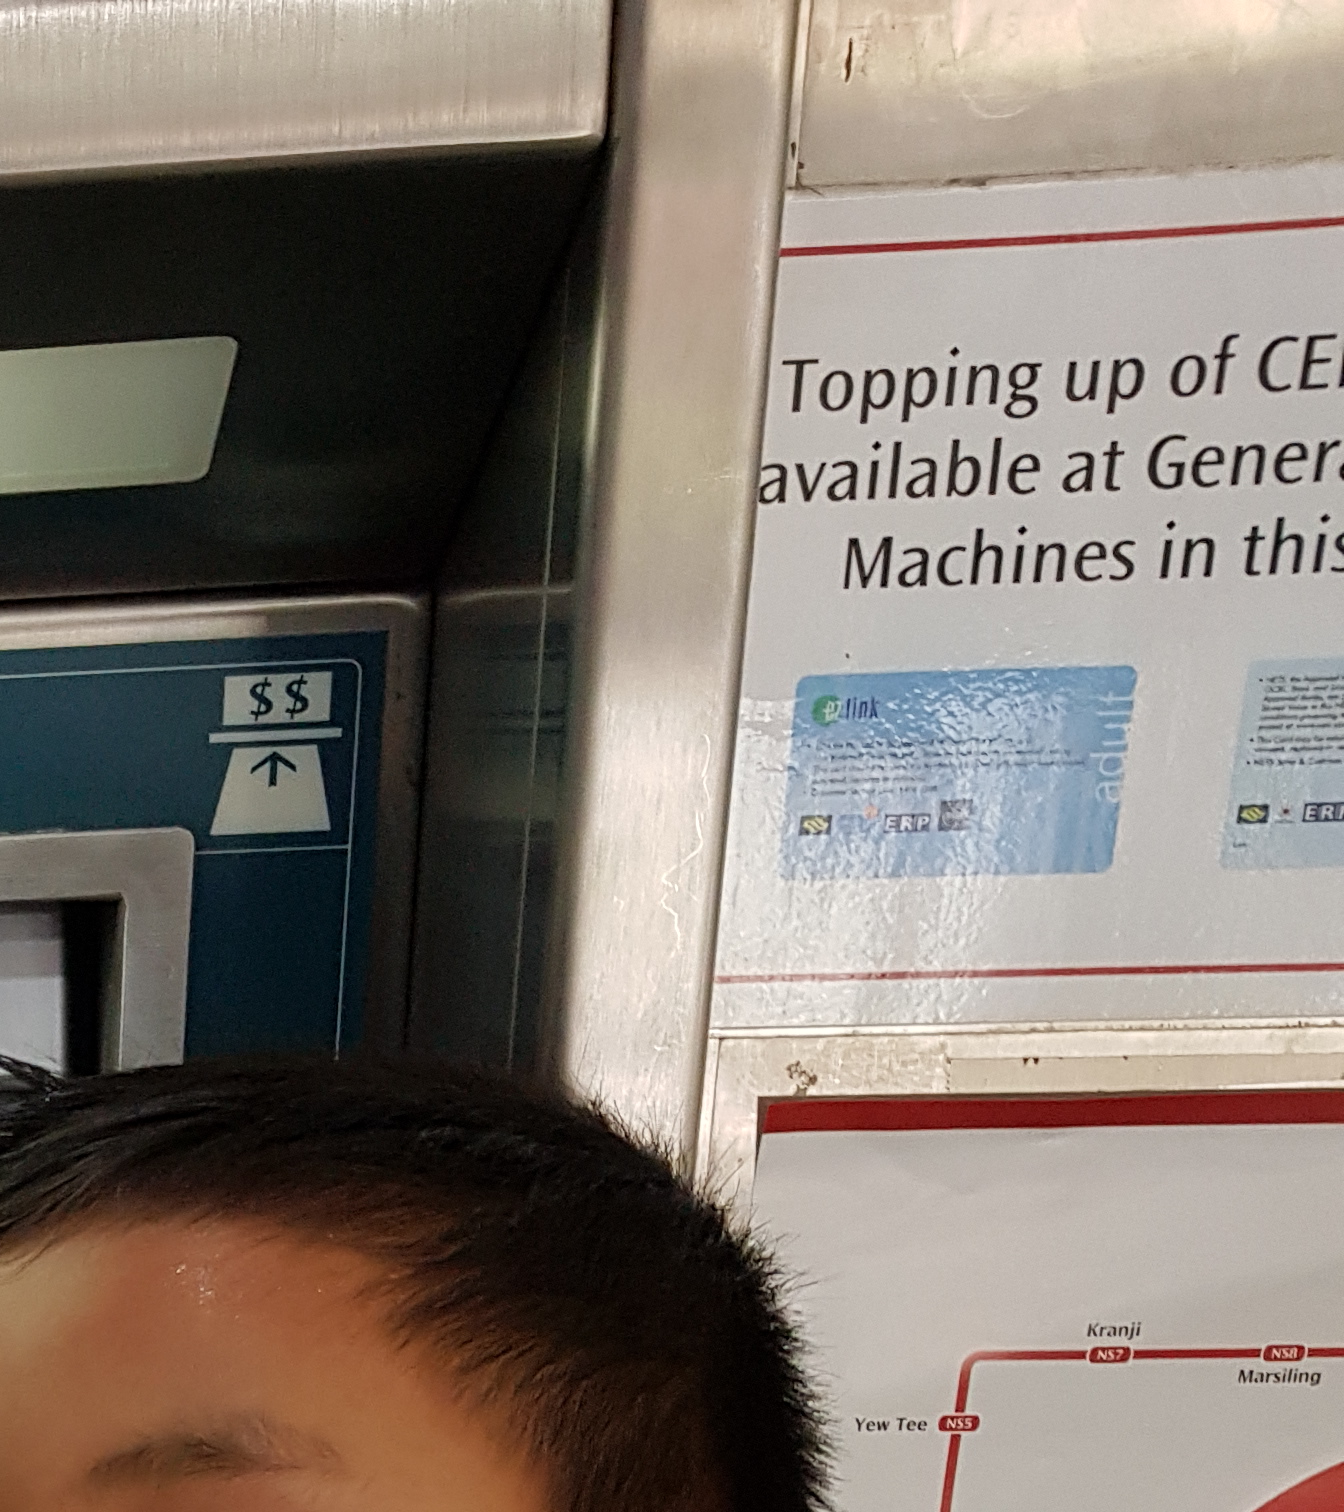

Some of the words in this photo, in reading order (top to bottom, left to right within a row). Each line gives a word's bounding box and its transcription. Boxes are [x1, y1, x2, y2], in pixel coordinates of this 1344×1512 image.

[783, 347, 1042, 425] Topping
[1065, 357, 1145, 414] up
[1169, 333, 1240, 397] of
[1259, 333, 1344, 394] CE
[758, 438, 1041, 504] available
[1062, 441, 1124, 493] at
[1148, 434, 1344, 492] Gener
[843, 526, 1136, 590] Machines
[1159, 520, 1216, 580] in
[1087, 1321, 1142, 1340] Kranji
[1096, 1348, 1125, 1361] NS7
[1270, 1347, 1299, 1360] NS8
[1237, 1367, 1322, 1386] Marsiling
[854, 1416, 891, 1432] Yew
[896, 1416, 928, 1432] Tee
[945, 1416, 973, 1430] NS5
